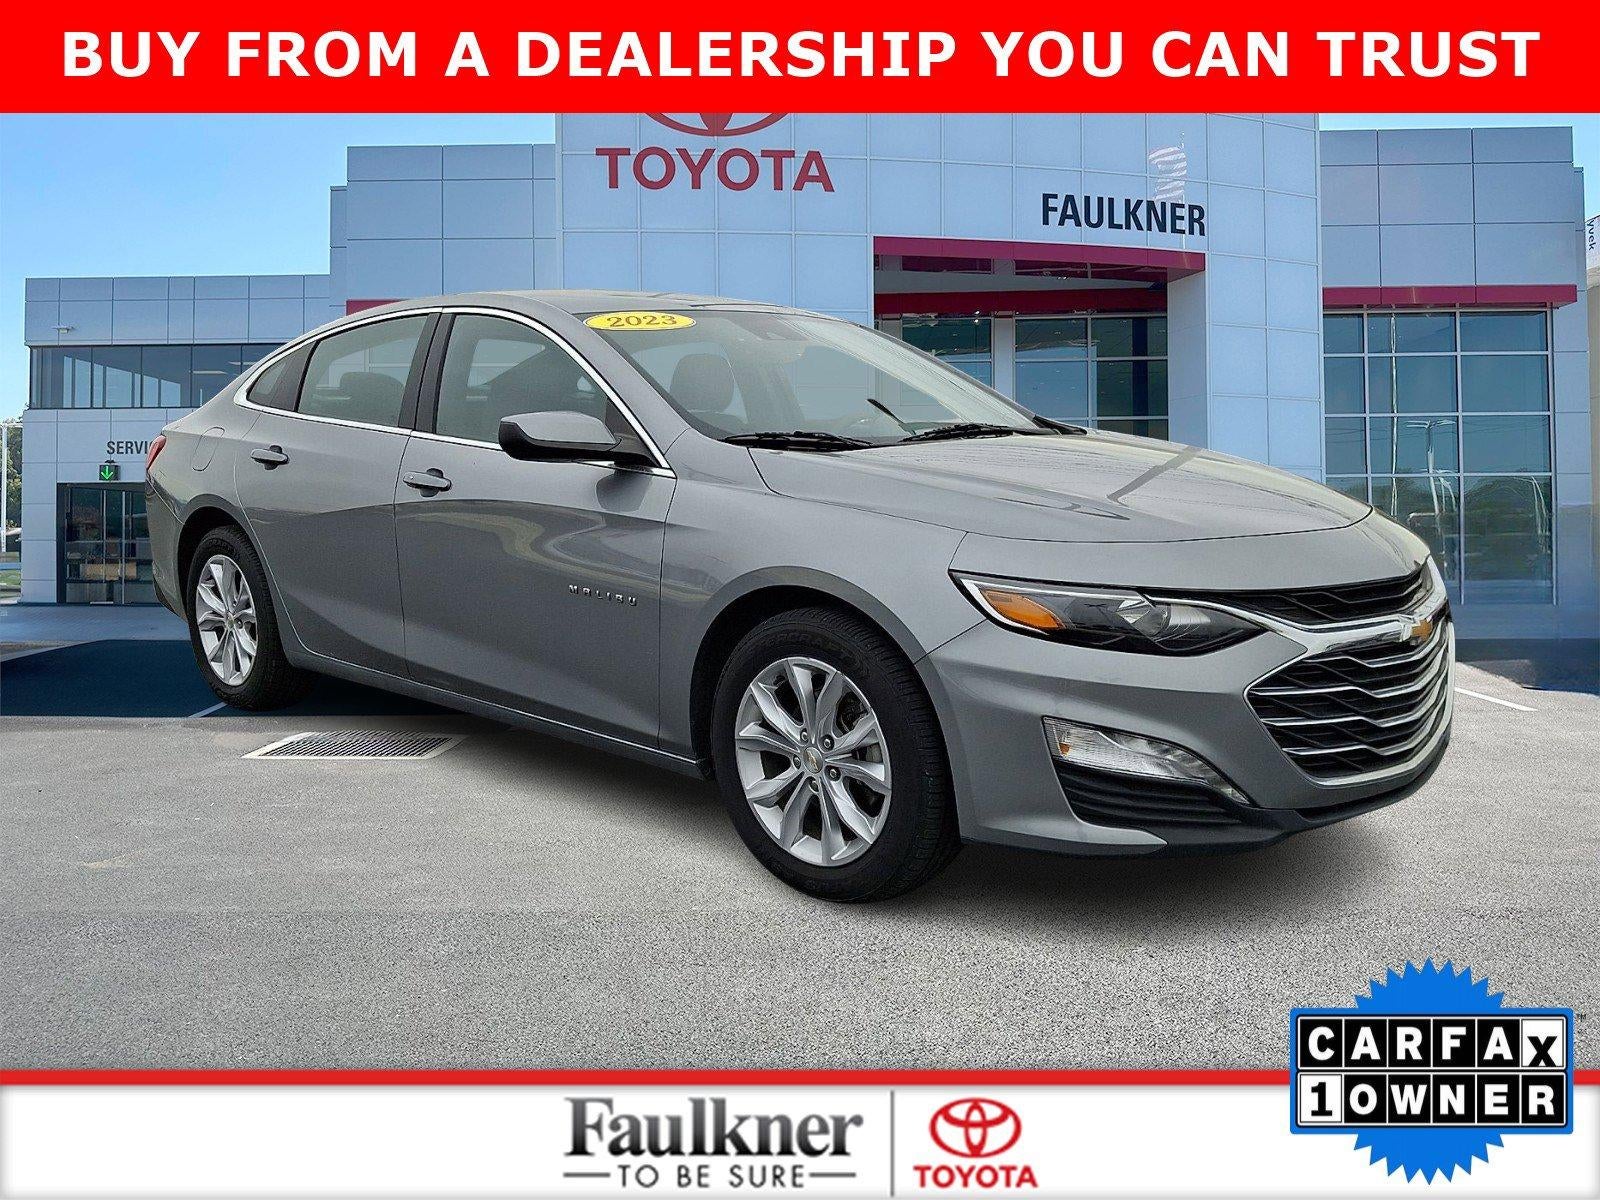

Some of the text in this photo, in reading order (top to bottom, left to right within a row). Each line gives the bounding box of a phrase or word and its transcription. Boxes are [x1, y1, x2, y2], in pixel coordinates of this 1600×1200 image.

[595, 146, 835, 192] TOYOTA
[1042, 193, 1206, 237] FAULKNER
[607, 315, 677, 327] 2023
[106, 440, 154, 455] SERVI
[568, 584, 638, 606] MALIBU
